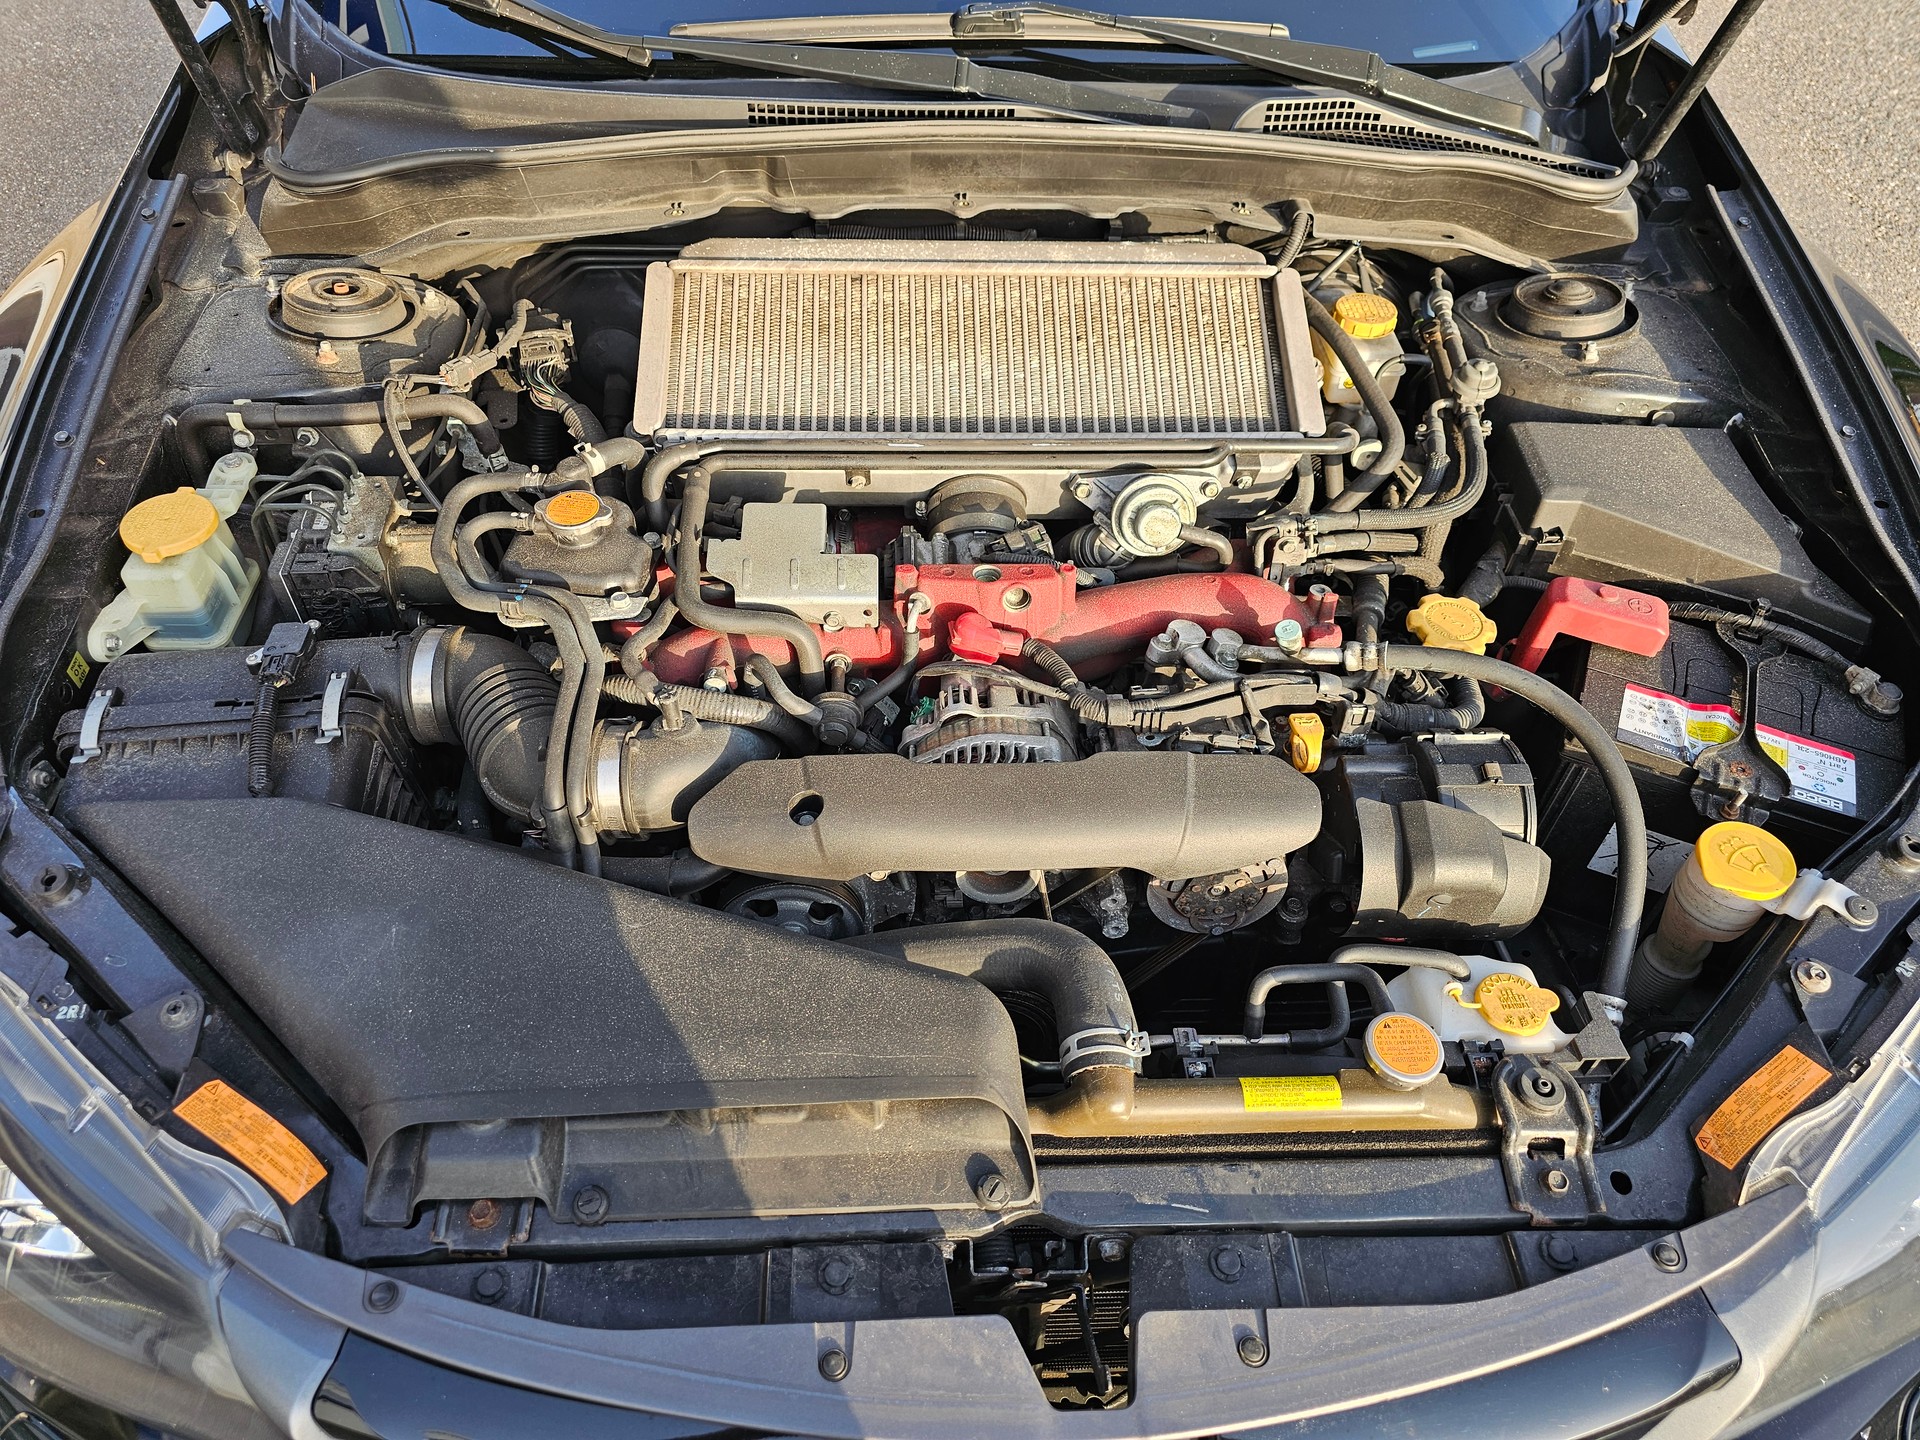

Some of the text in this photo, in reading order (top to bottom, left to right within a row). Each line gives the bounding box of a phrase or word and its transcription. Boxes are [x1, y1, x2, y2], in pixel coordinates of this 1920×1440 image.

[1633, 727, 1672, 743] WARRANTY
[1829, 760, 1847, 772] Part
[1802, 772, 1837, 786] INDICATOR
[1481, 974, 1533, 994] COOLANT
